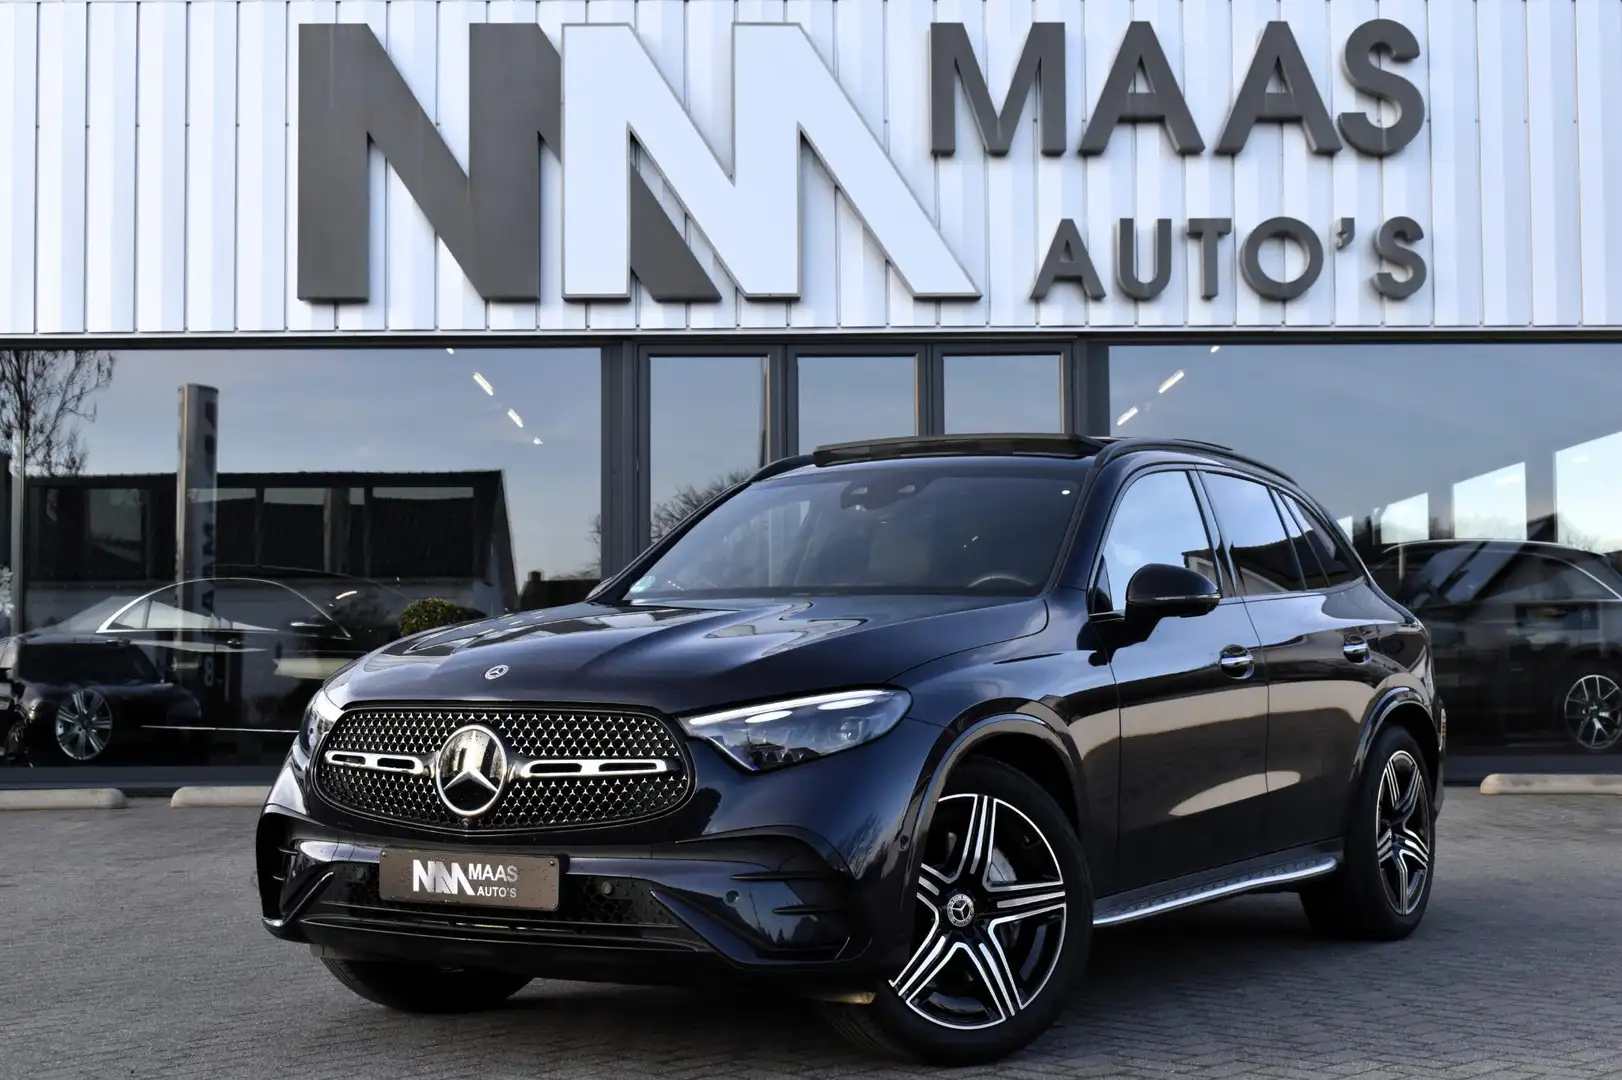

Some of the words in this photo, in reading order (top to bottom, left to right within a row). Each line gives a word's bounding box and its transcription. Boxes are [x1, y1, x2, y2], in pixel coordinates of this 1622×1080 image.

[930, 18, 1426, 157] MAAS
[1030, 216, 1427, 301] AUTO'S
[468, 863, 519, 882] MAAS
[477, 886, 518, 898] AUTO'S
